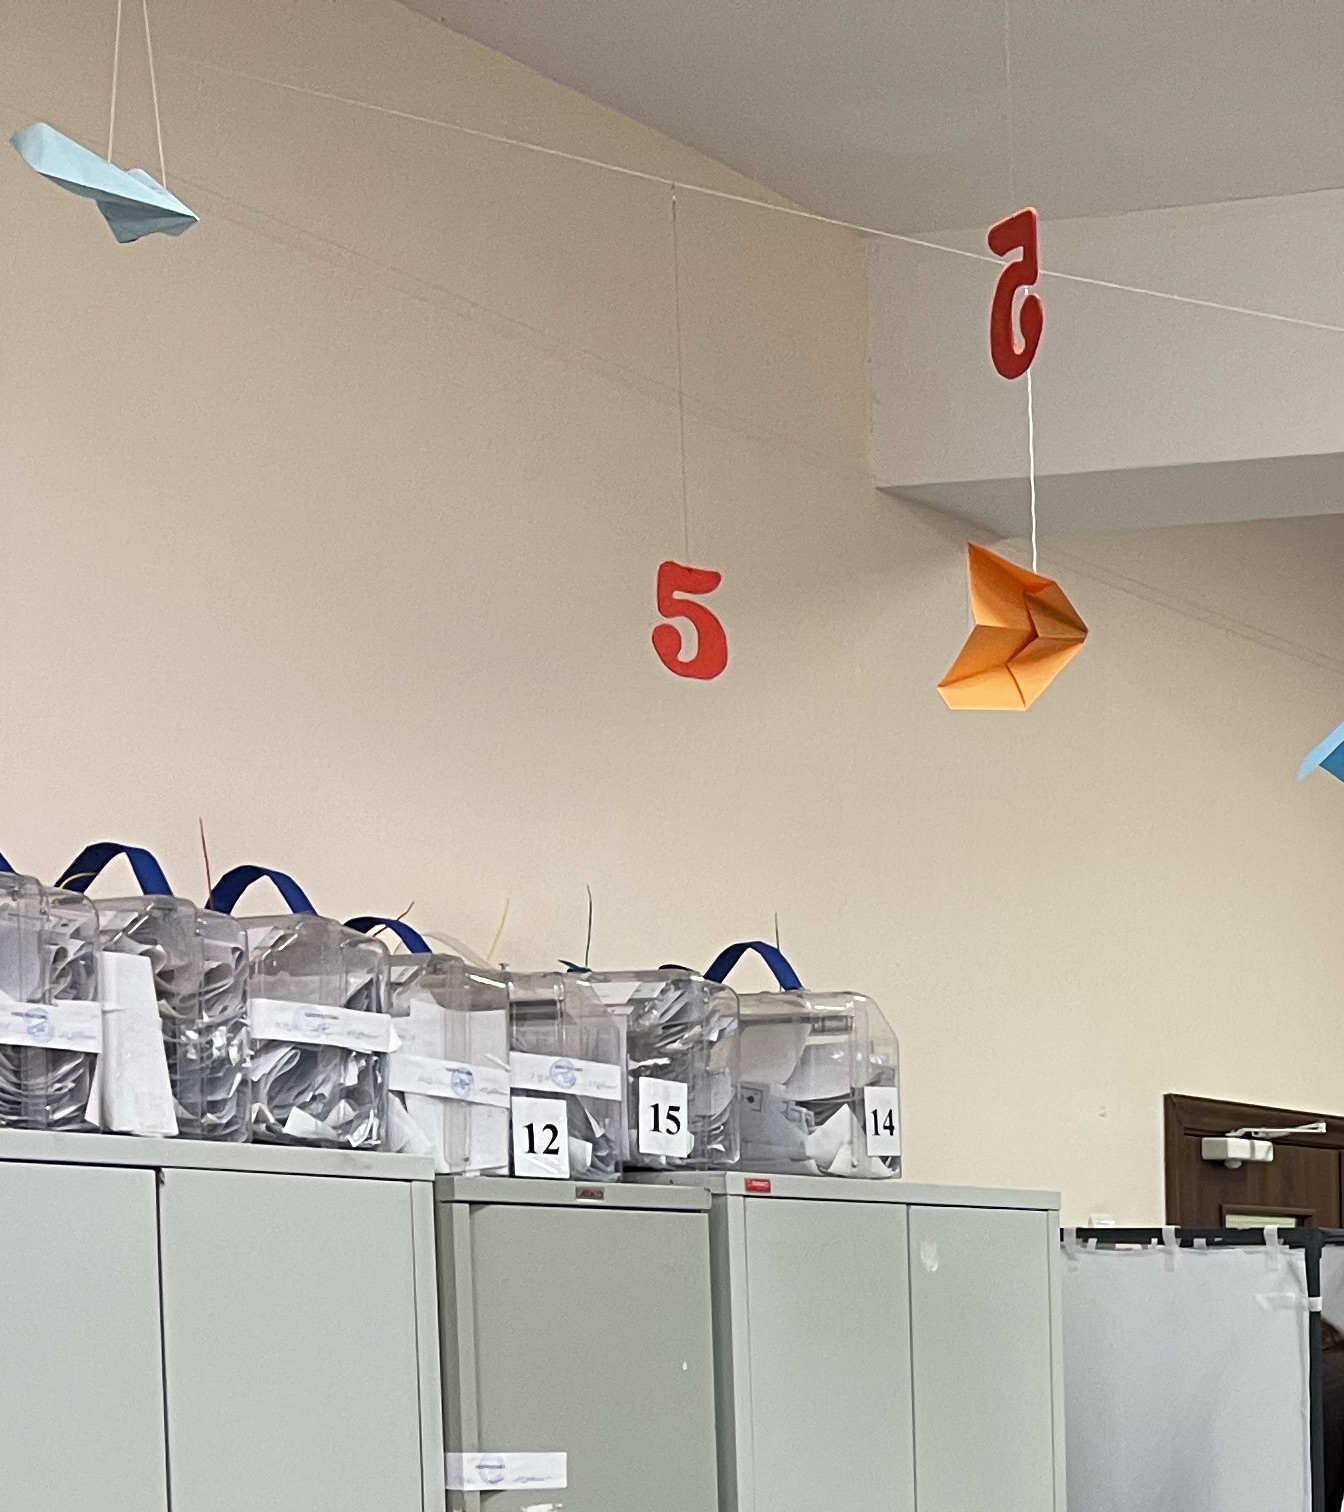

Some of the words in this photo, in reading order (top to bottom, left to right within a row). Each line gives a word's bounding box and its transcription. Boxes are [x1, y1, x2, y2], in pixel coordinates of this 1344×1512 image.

[651, 561, 729, 681] 5
[649, 1103, 681, 1135] 15
[870, 1109, 895, 1137] 14
[523, 1123, 560, 1155] 12
